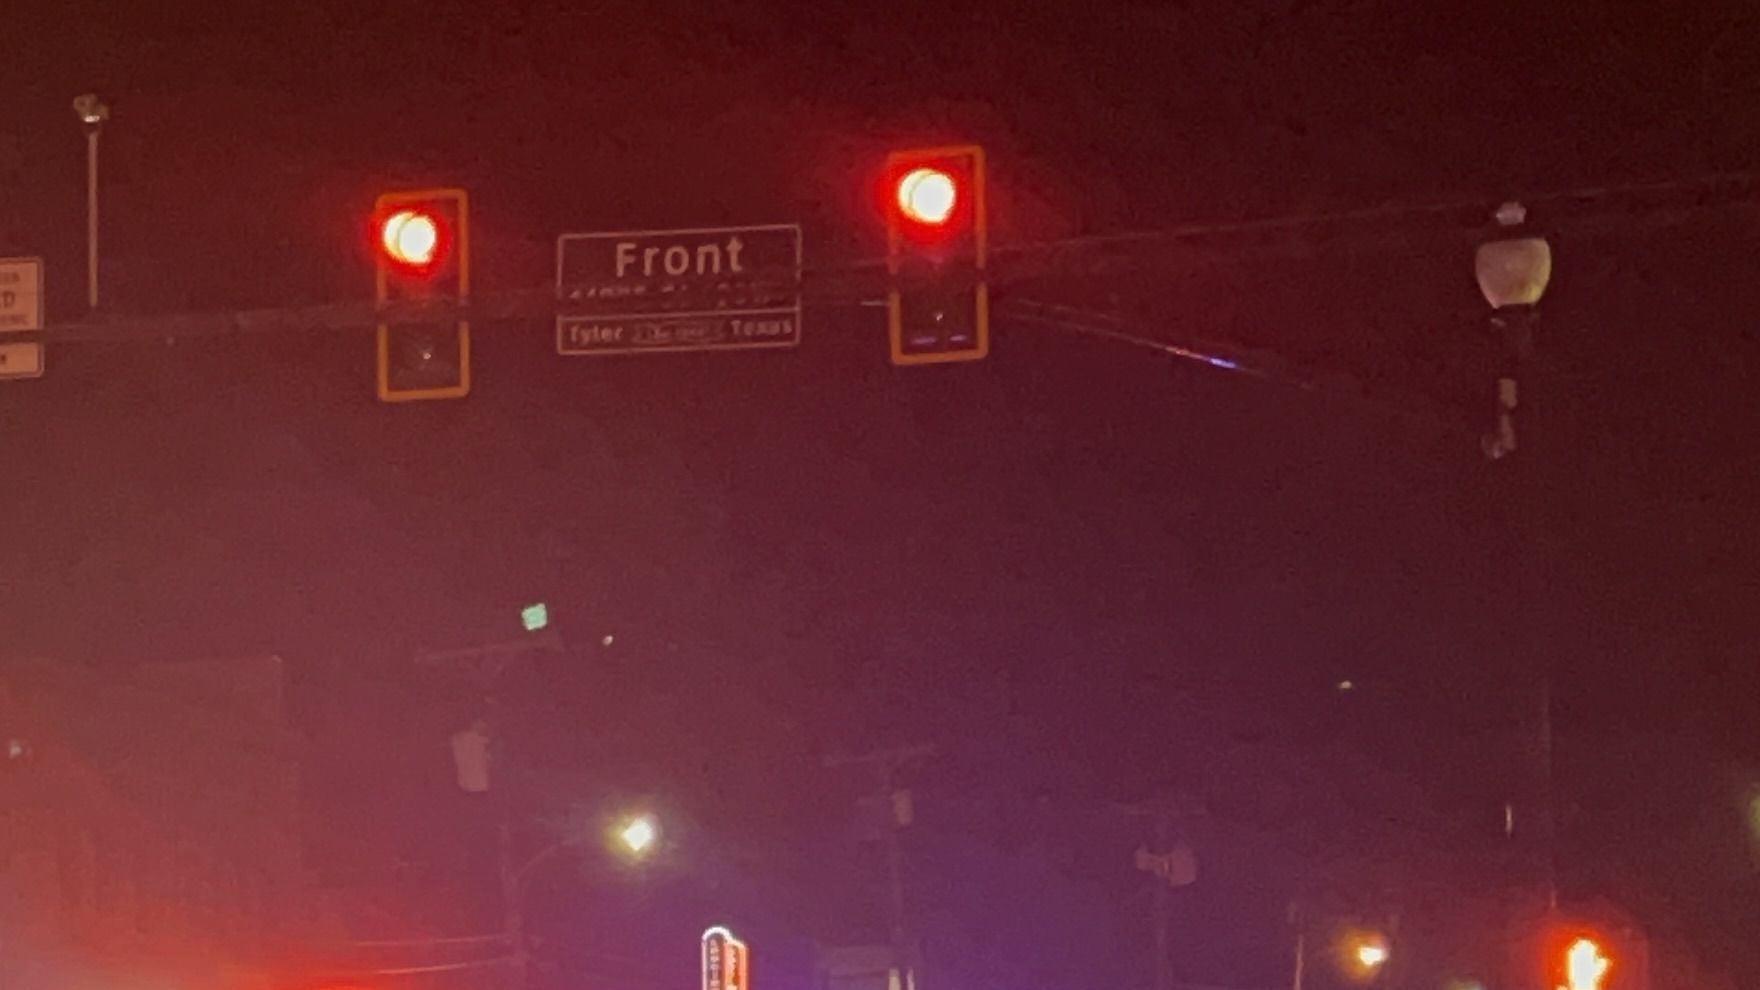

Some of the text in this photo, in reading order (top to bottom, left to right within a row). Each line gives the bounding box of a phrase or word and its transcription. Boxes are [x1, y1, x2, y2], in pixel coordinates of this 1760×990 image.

[615, 236, 743, 278] Front
[570, 325, 624, 345] Tyler
[730, 318, 793, 336] Texas
